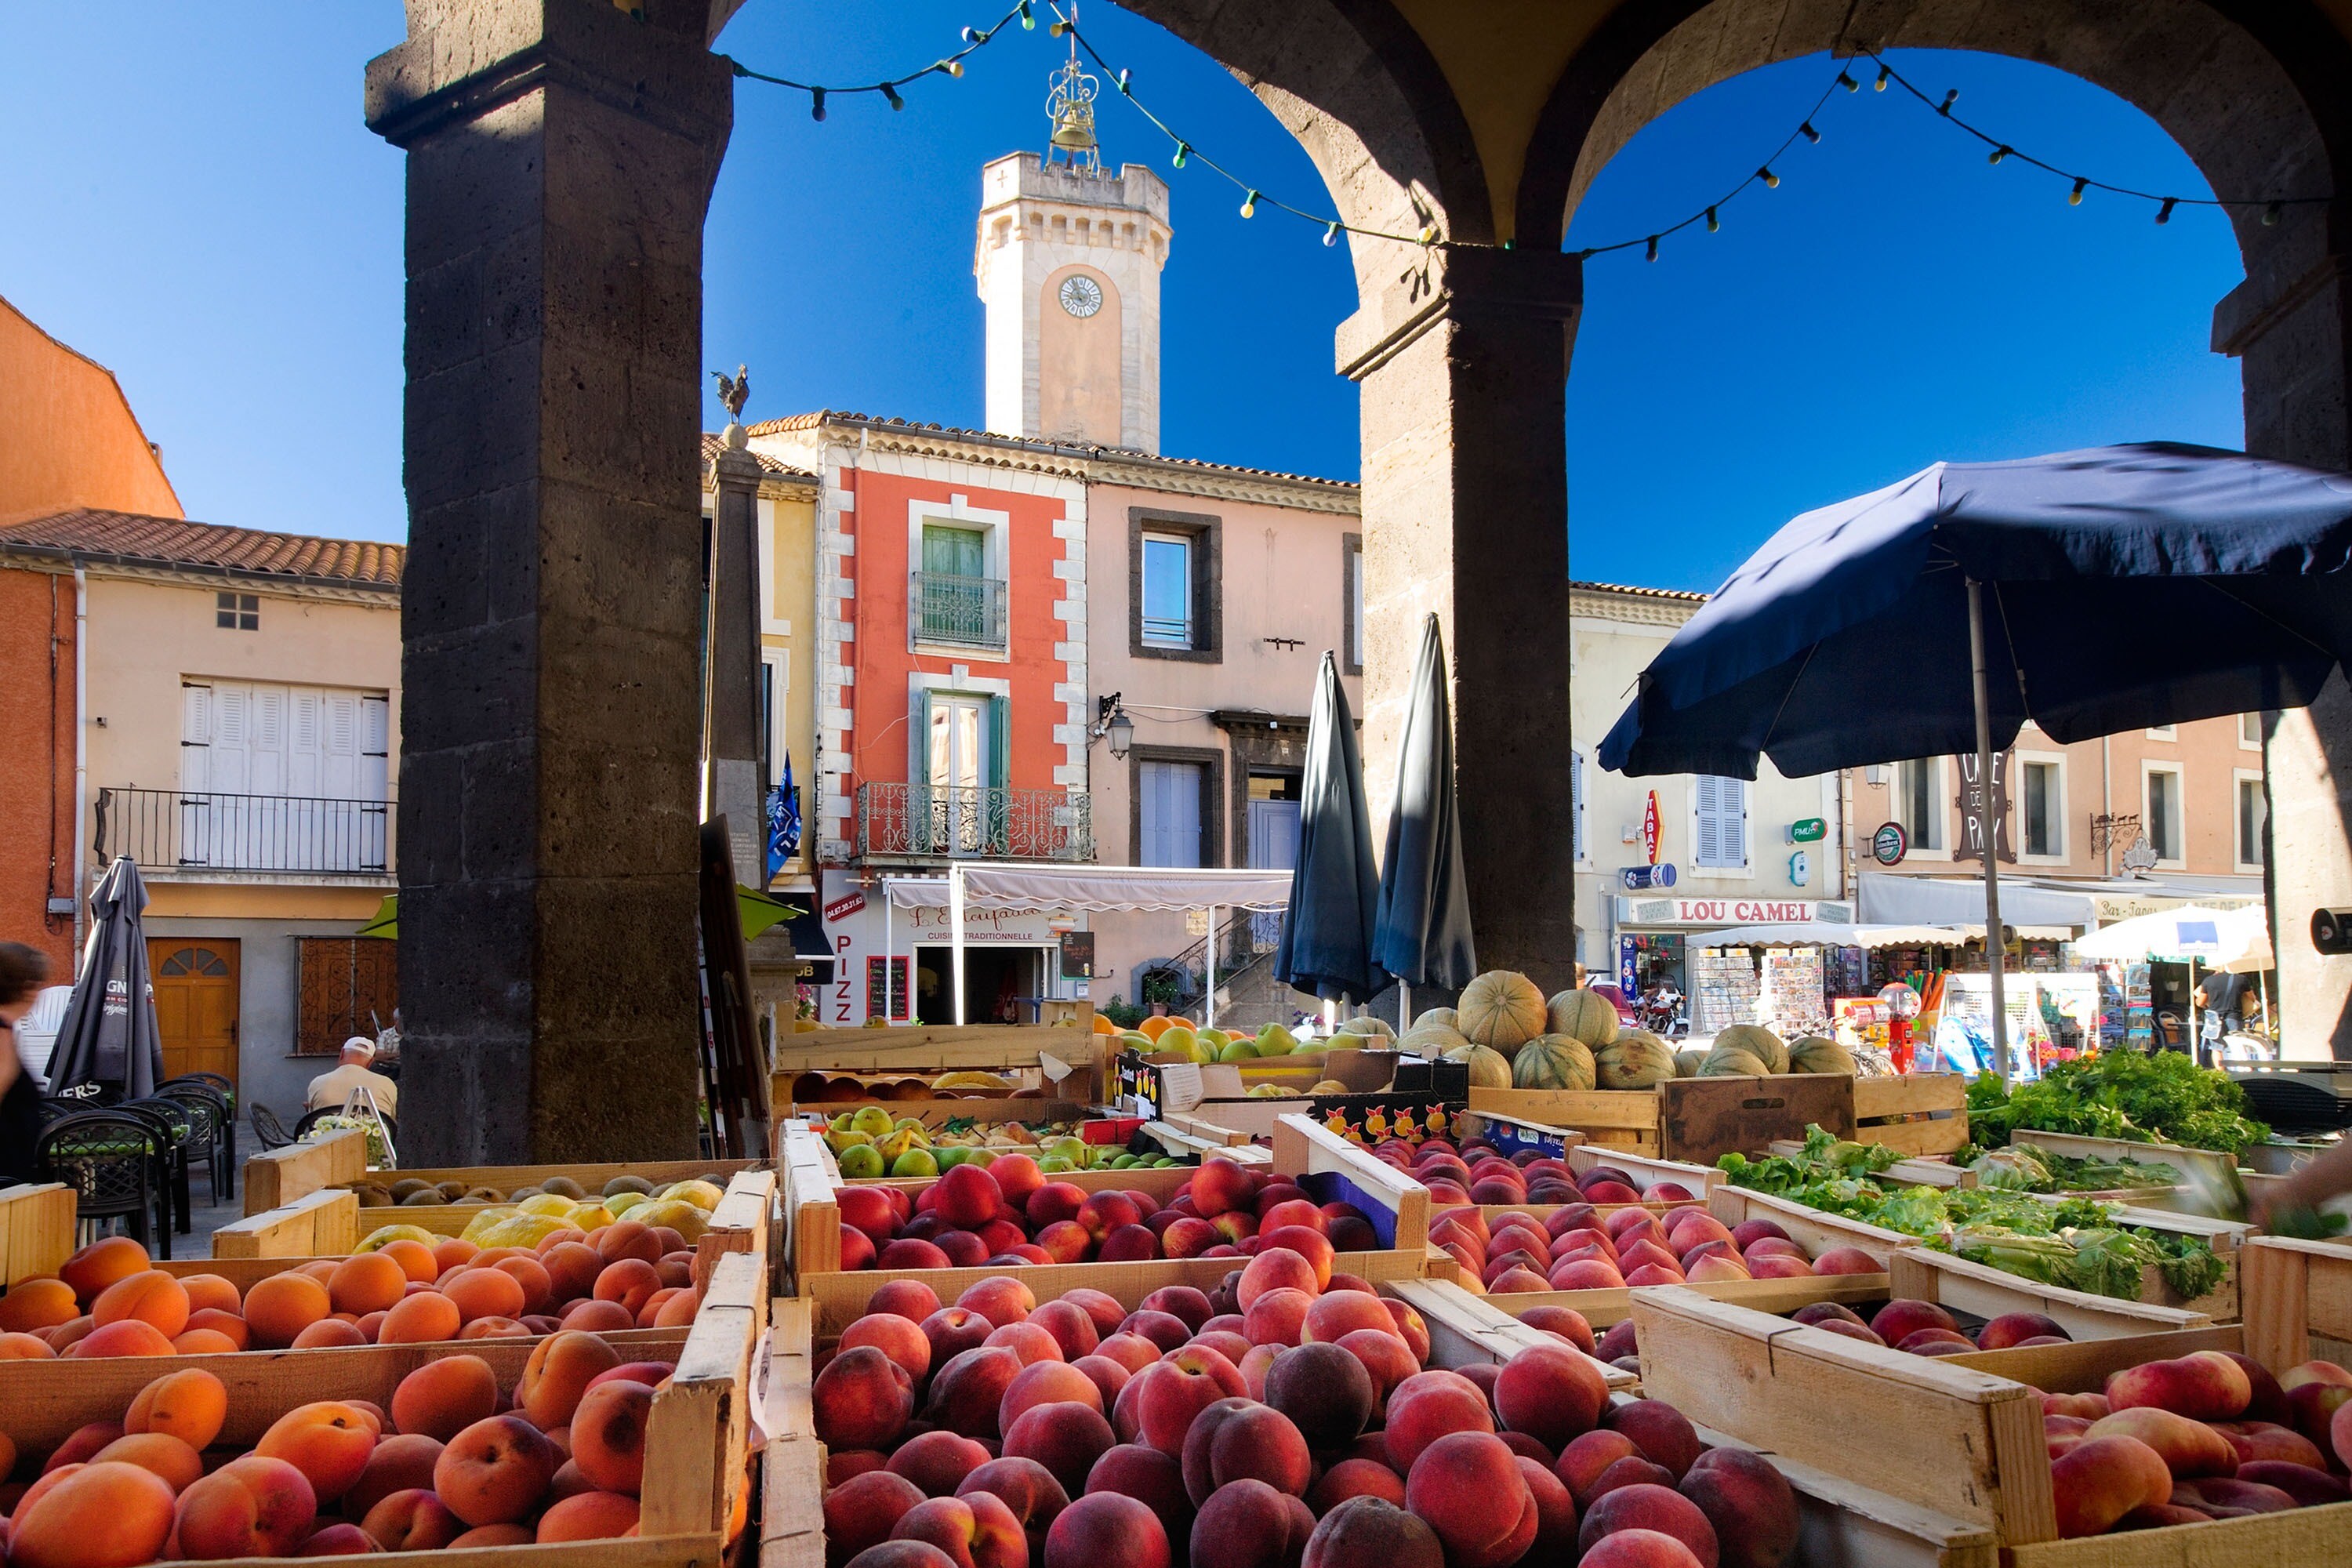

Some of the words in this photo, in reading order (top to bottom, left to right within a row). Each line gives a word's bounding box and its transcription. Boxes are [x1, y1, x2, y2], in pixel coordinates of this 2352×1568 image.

[1794, 828, 1810, 837] PMU
[826, 896, 863, 919] 04.67.30.31.63
[1680, 902, 1726, 920] LOU
[1735, 902, 1812, 921] CAMEL
[2101, 900, 2120, 916] Bar
[836, 935, 851, 1021] PIZZ
